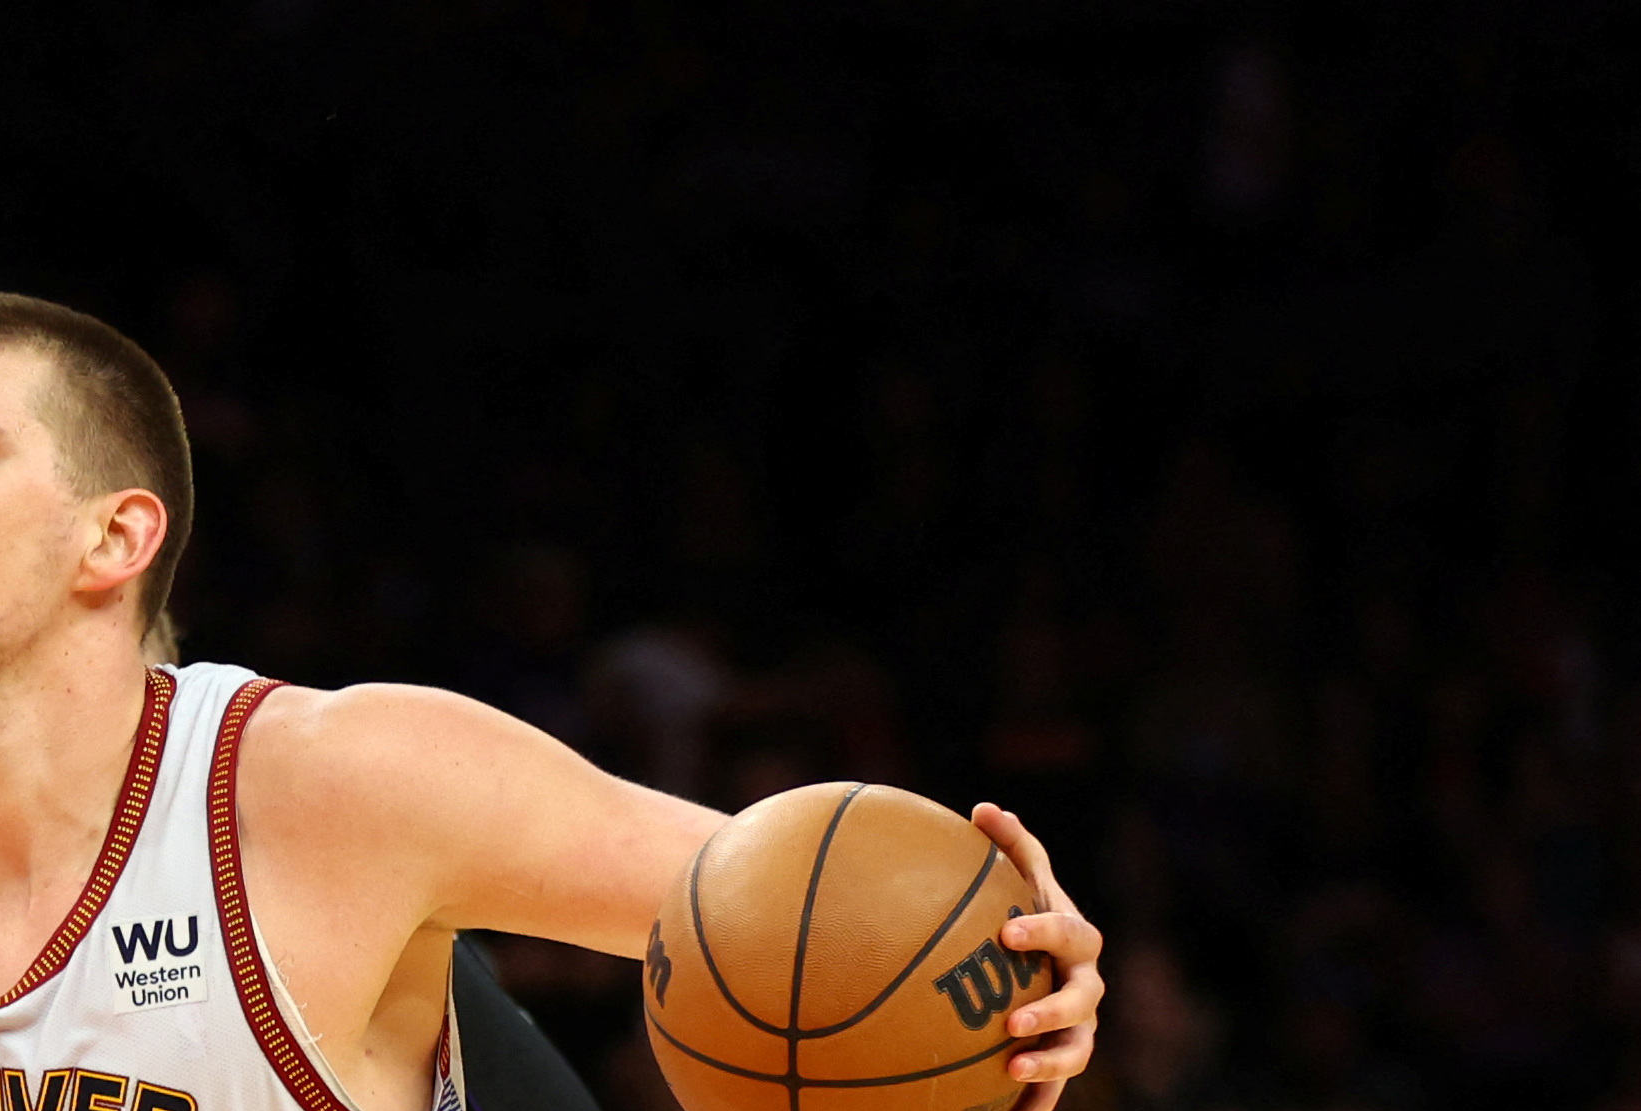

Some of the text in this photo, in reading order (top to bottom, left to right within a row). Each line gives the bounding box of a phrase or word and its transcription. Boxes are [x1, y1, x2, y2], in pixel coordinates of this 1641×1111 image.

[111, 915, 199, 964] WU
[115, 961, 201, 989] Western
[131, 983, 190, 1007] Union
